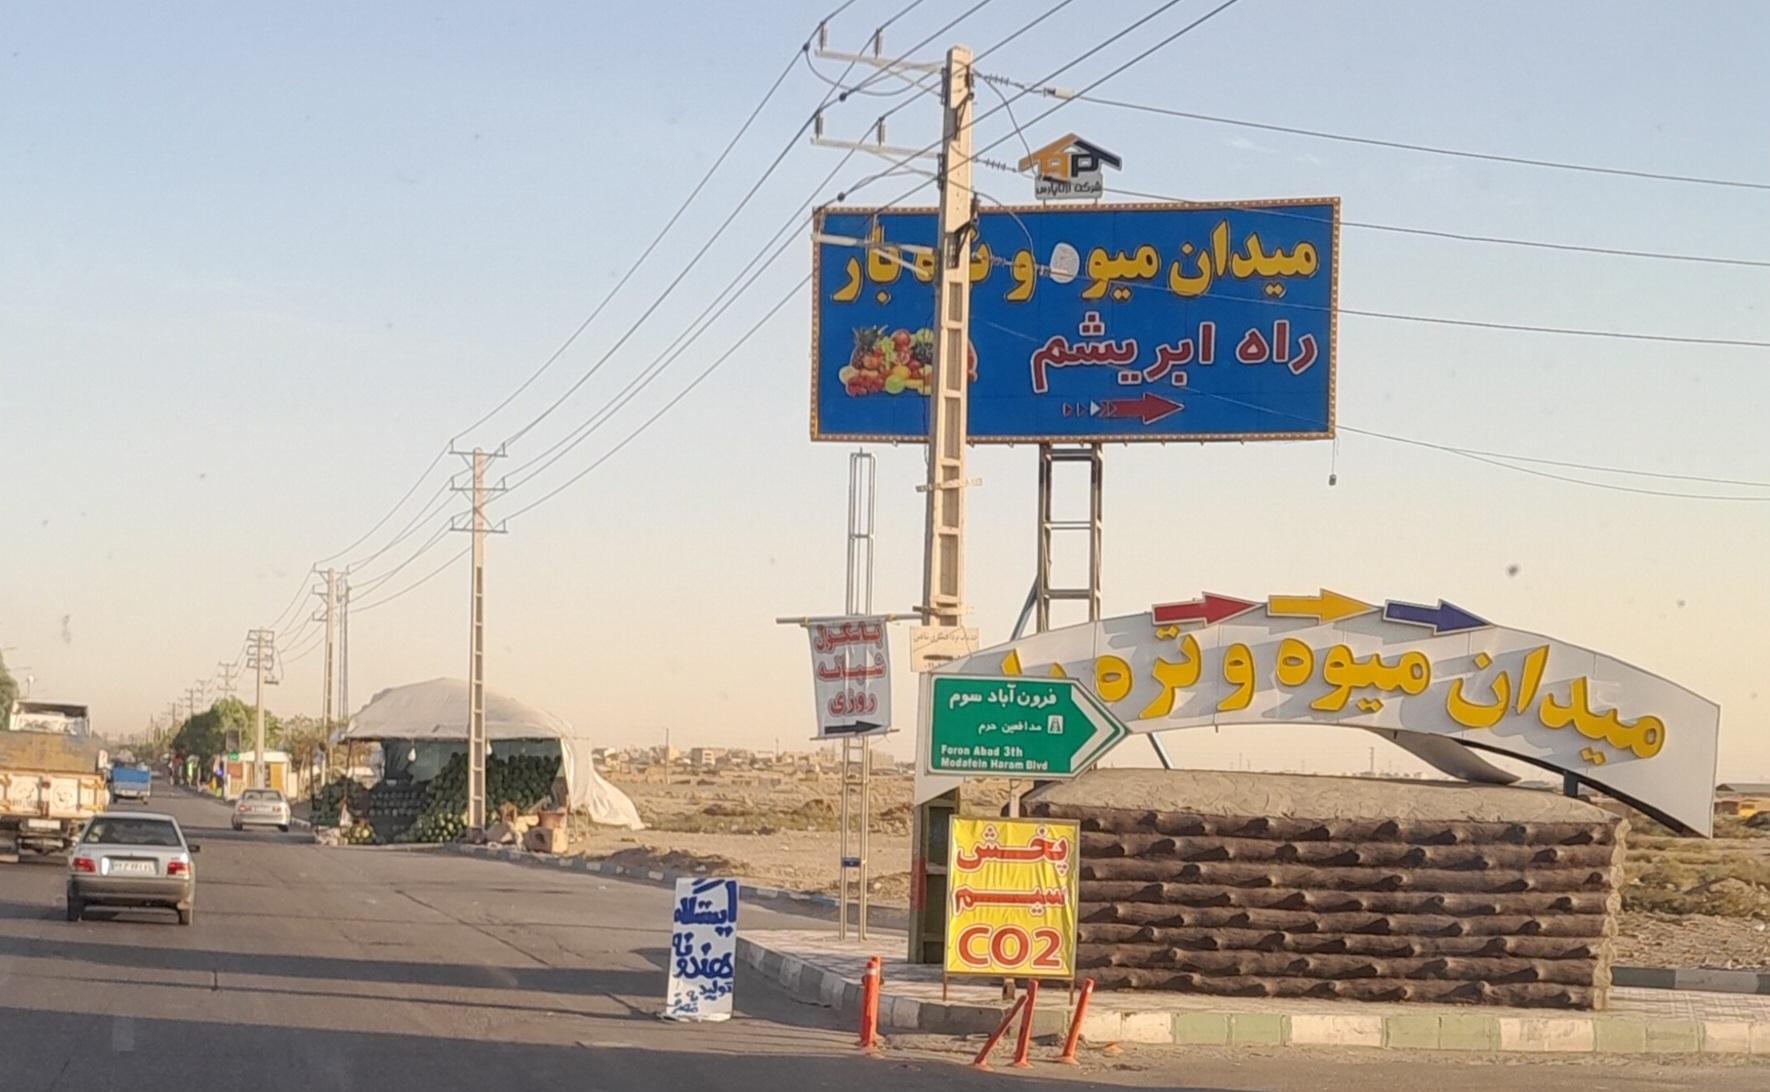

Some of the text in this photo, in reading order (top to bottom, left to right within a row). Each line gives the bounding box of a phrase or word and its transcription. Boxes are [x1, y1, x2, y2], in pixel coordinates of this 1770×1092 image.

[831, 222, 903, 304] بار
[1005, 249, 1036, 302] و
[1168, 219, 1319, 297] میدان
[1031, 311, 1318, 394] راه ابریشم
[827, 689, 878, 717] روزی
[949, 683, 1057, 709] فرون آباد سوم
[1094, 624, 1666, 766] میدان میوه و تره
[978, 720, 1042, 735] مدافعین حرم
[941, 744, 1023, 757] Foron Abad 3th
[990, 759, 1023, 770] Haram
[1026, 760, 1048, 771] Blvd
[956, 824, 1069, 876] پخش
[955, 885, 1068, 916] سیم
[957, 924, 1063, 969] CO2
[699, 979, 733, 1001] تولید
